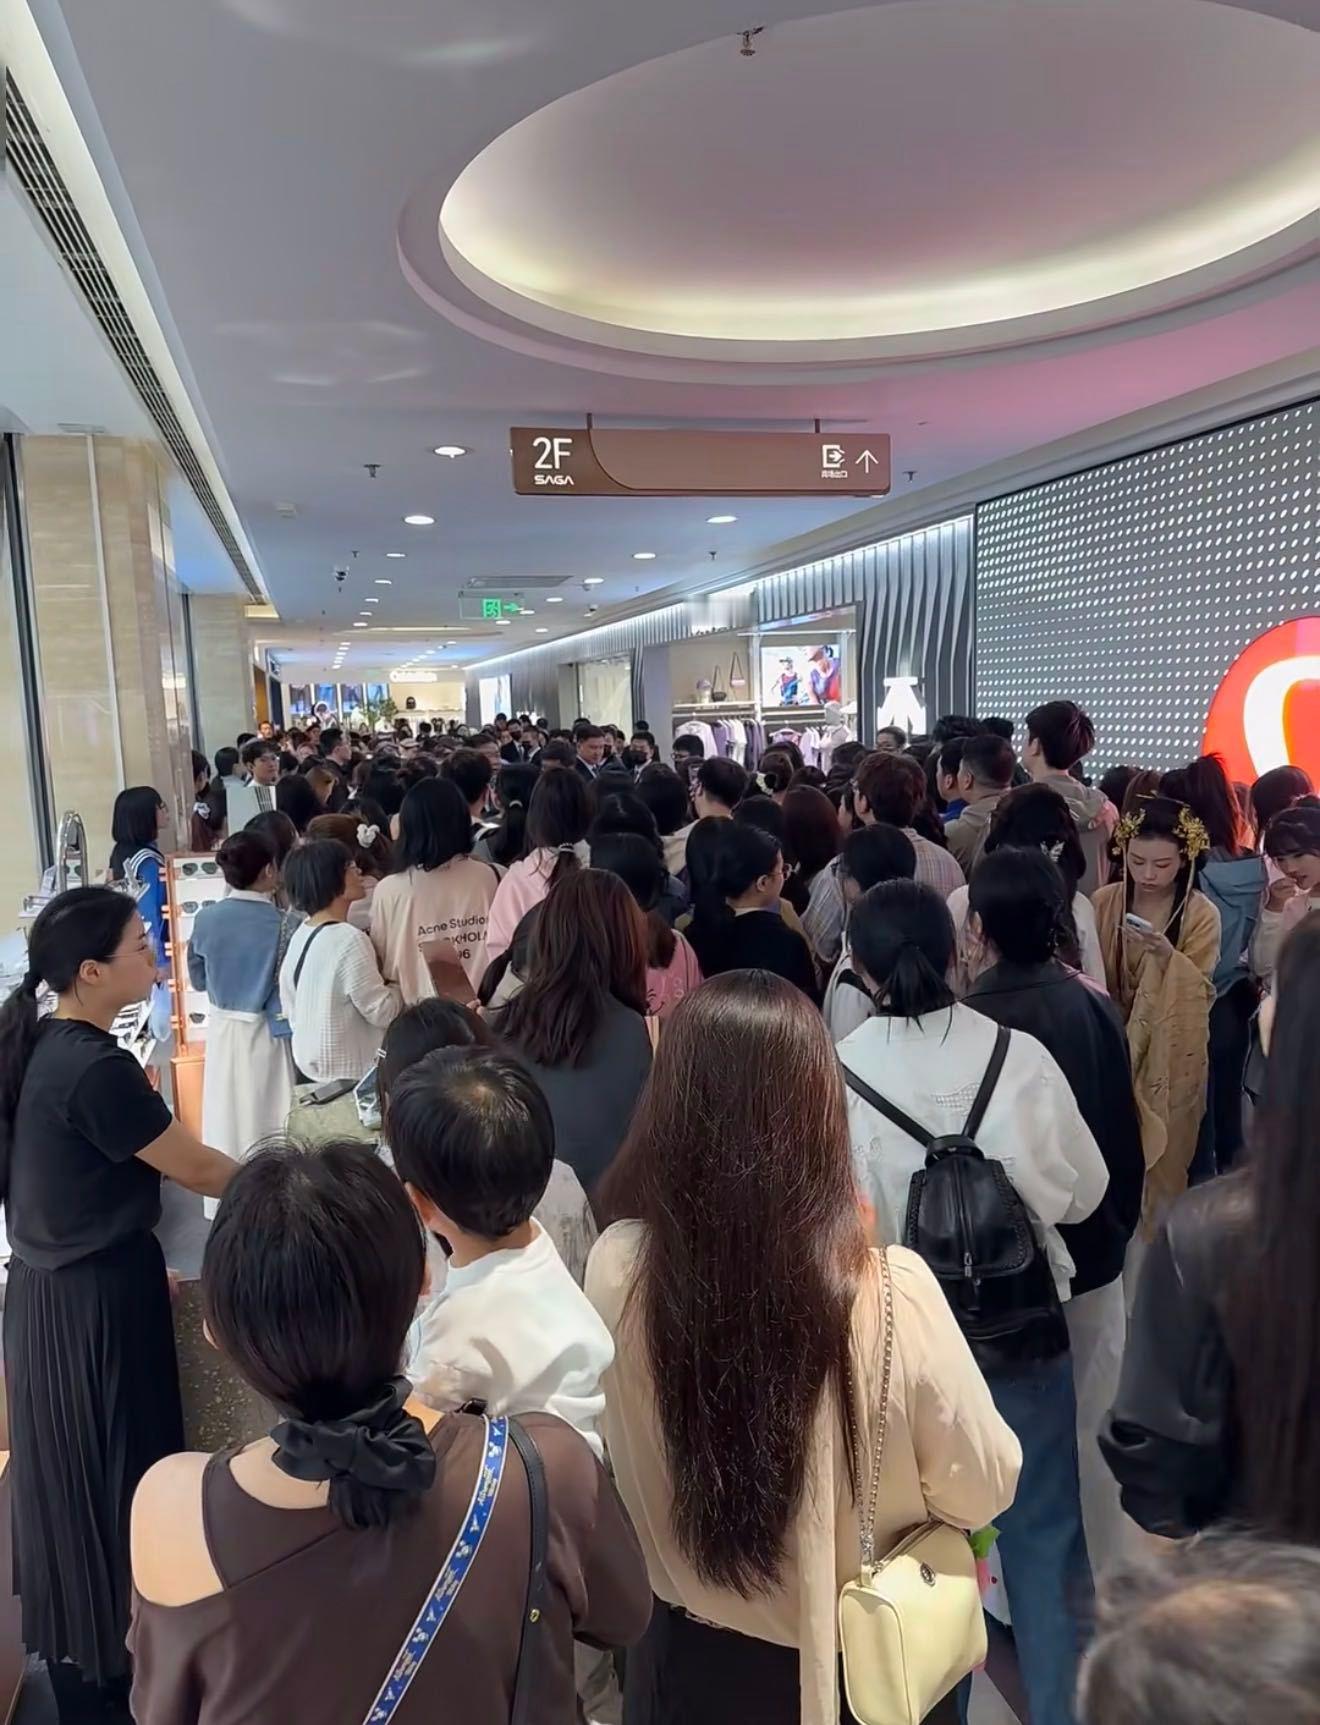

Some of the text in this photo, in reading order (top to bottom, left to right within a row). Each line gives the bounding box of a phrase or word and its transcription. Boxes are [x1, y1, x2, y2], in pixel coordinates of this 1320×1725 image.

[533, 436, 573, 469] 2F
[534, 474, 575, 486] SAGA
[418, 923, 447, 936] Acne
